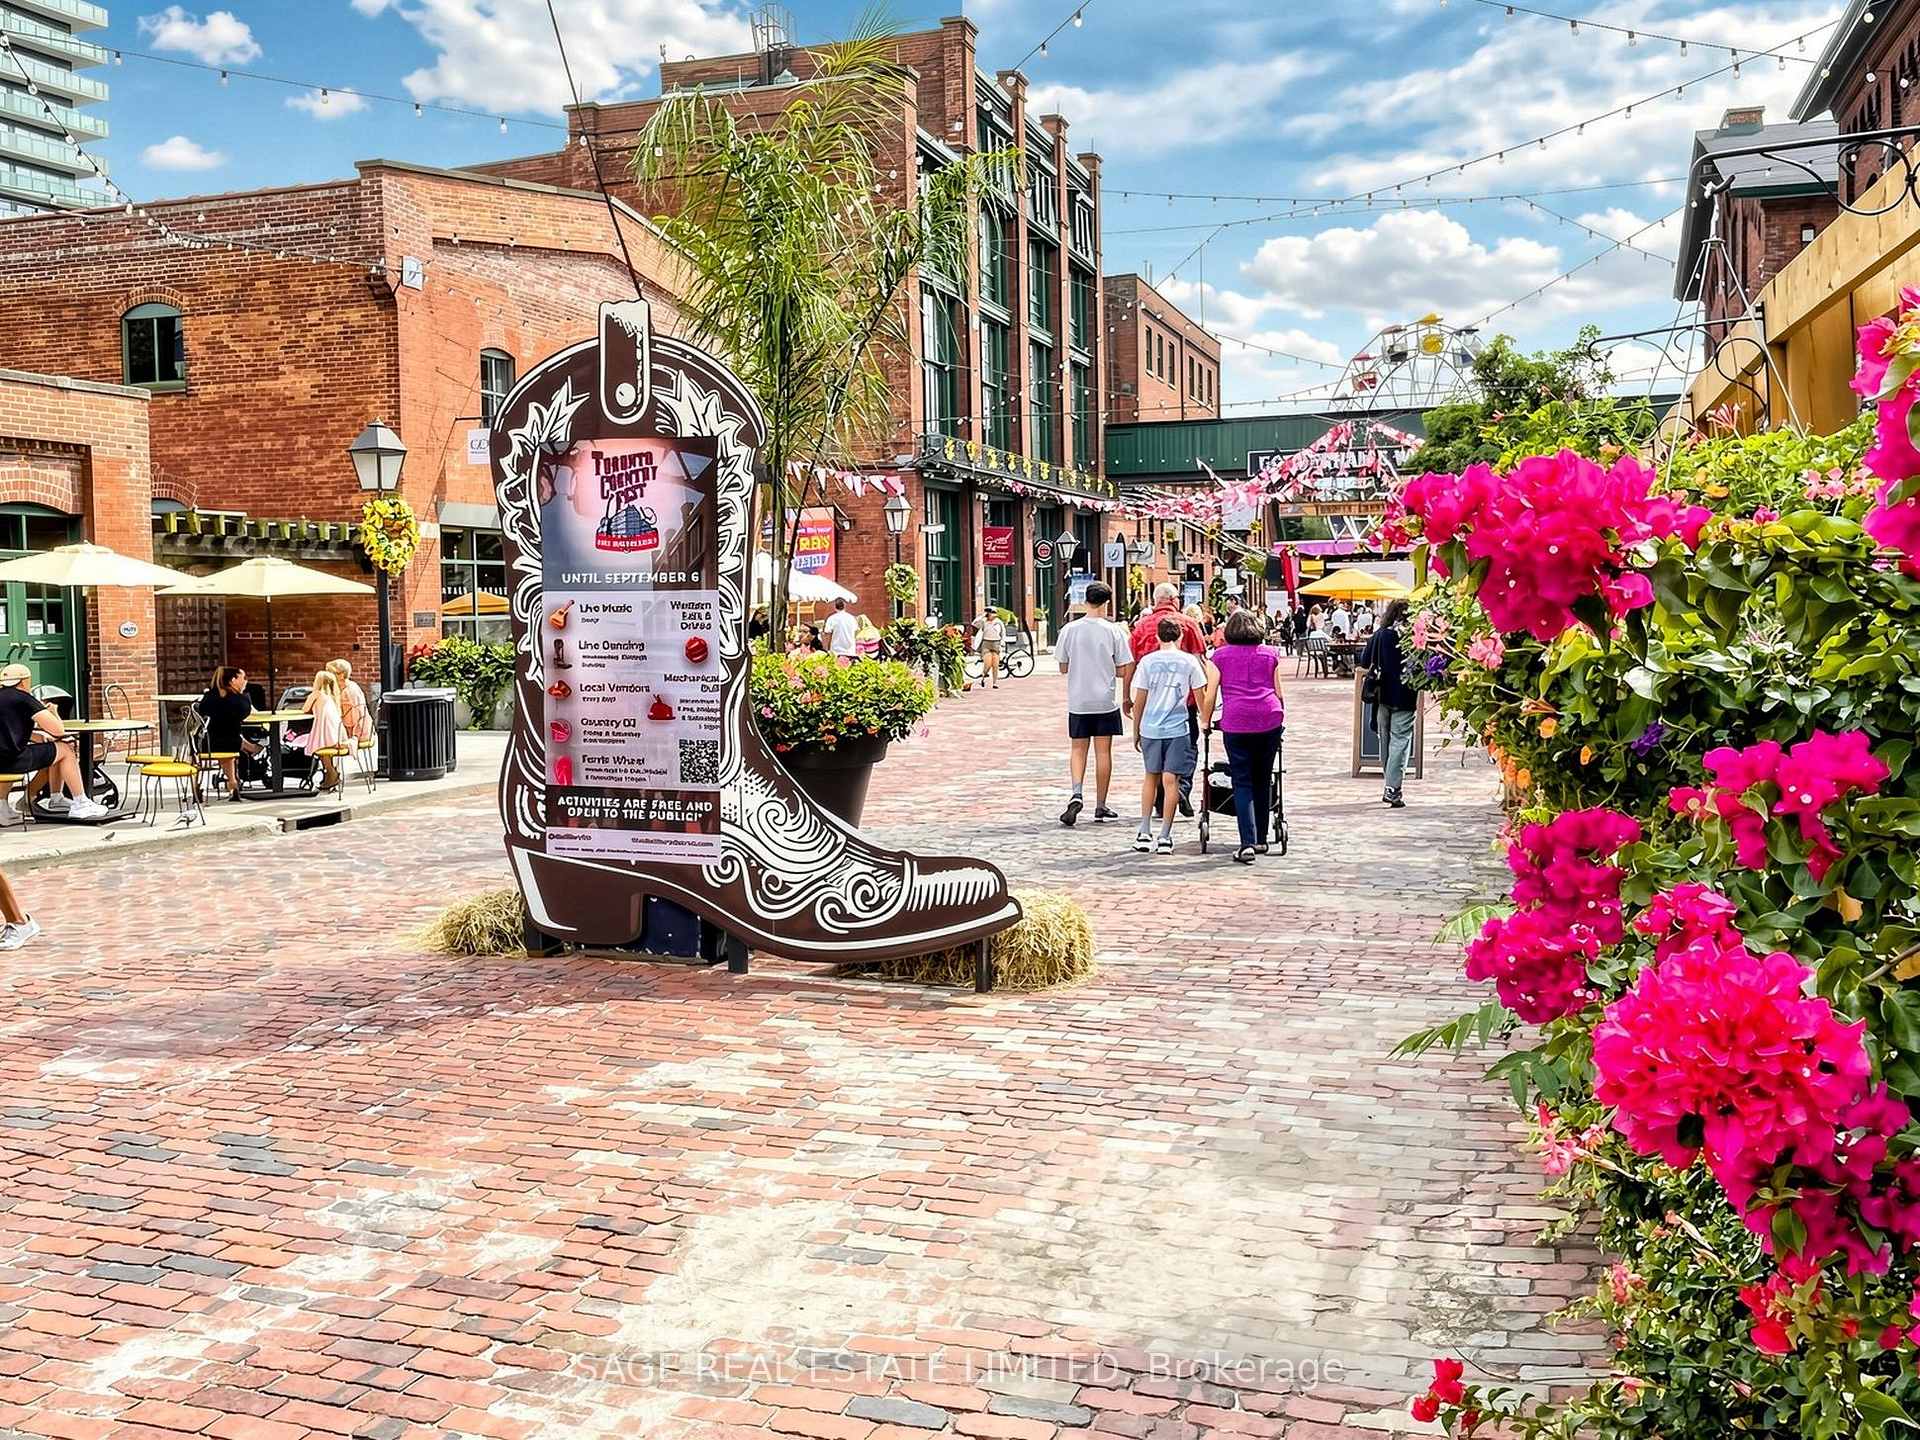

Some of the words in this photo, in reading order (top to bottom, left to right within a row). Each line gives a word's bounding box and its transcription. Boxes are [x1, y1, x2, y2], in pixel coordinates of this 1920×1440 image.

[601, 466, 658, 499] COUNTRY
[561, 573, 601, 584] UNTIL
[605, 572, 687, 584] SEPTEMBER
[691, 572, 699, 582] 6
[602, 604, 632, 613] Music
[578, 640, 600, 650] Line
[580, 683, 605, 692] Local
[608, 683, 650, 693] Vendors
[580, 718, 621, 729] Country
[557, 796, 620, 809] ACTIVITIES
[624, 799, 647, 809] ARE
[652, 800, 682, 811] FREE
[686, 801, 713, 812] AND
[567, 807, 600, 817] OPEN
[604, 808, 618, 818] TO
[622, 809, 645, 820] THE
